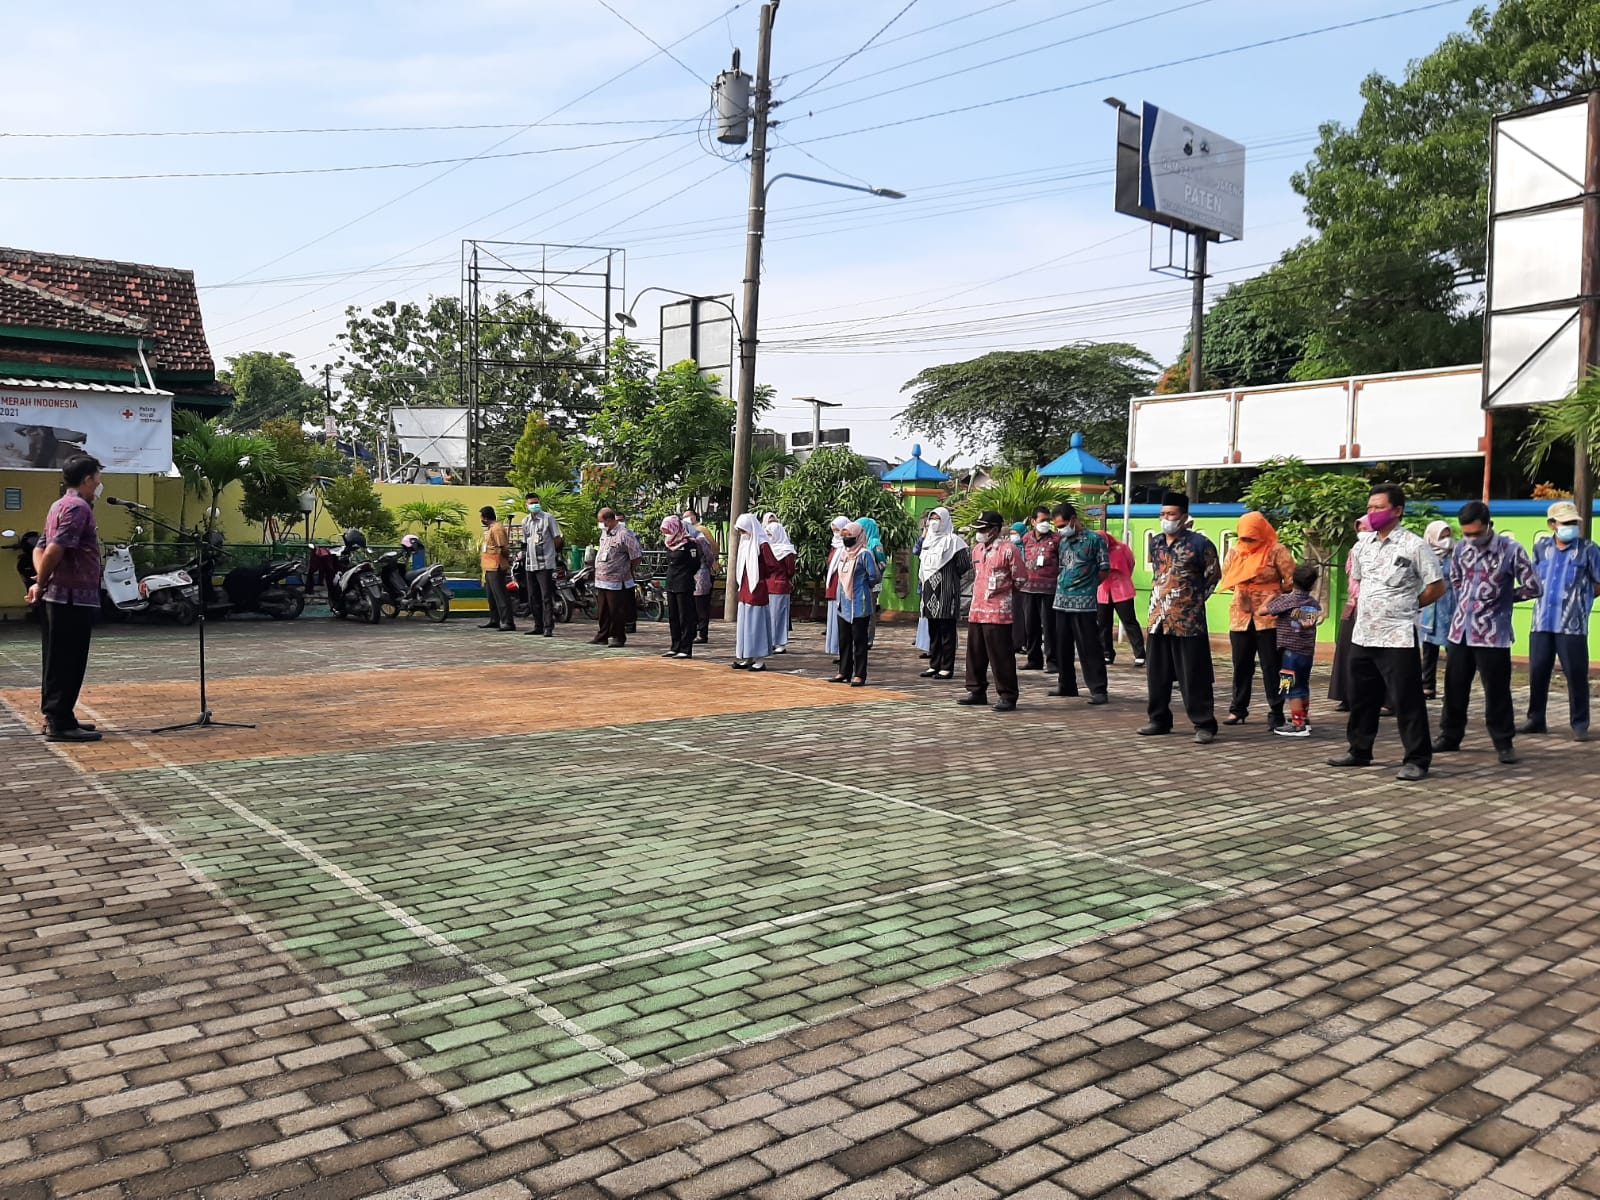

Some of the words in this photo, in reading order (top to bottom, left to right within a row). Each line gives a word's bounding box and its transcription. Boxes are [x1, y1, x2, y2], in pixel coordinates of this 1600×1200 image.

[1184, 184, 1222, 213] PATEN
[1, 397, 31, 406] MERAH
[33, 398, 79, 408] INDONESIA
[0, 408, 19, 416] 2021
